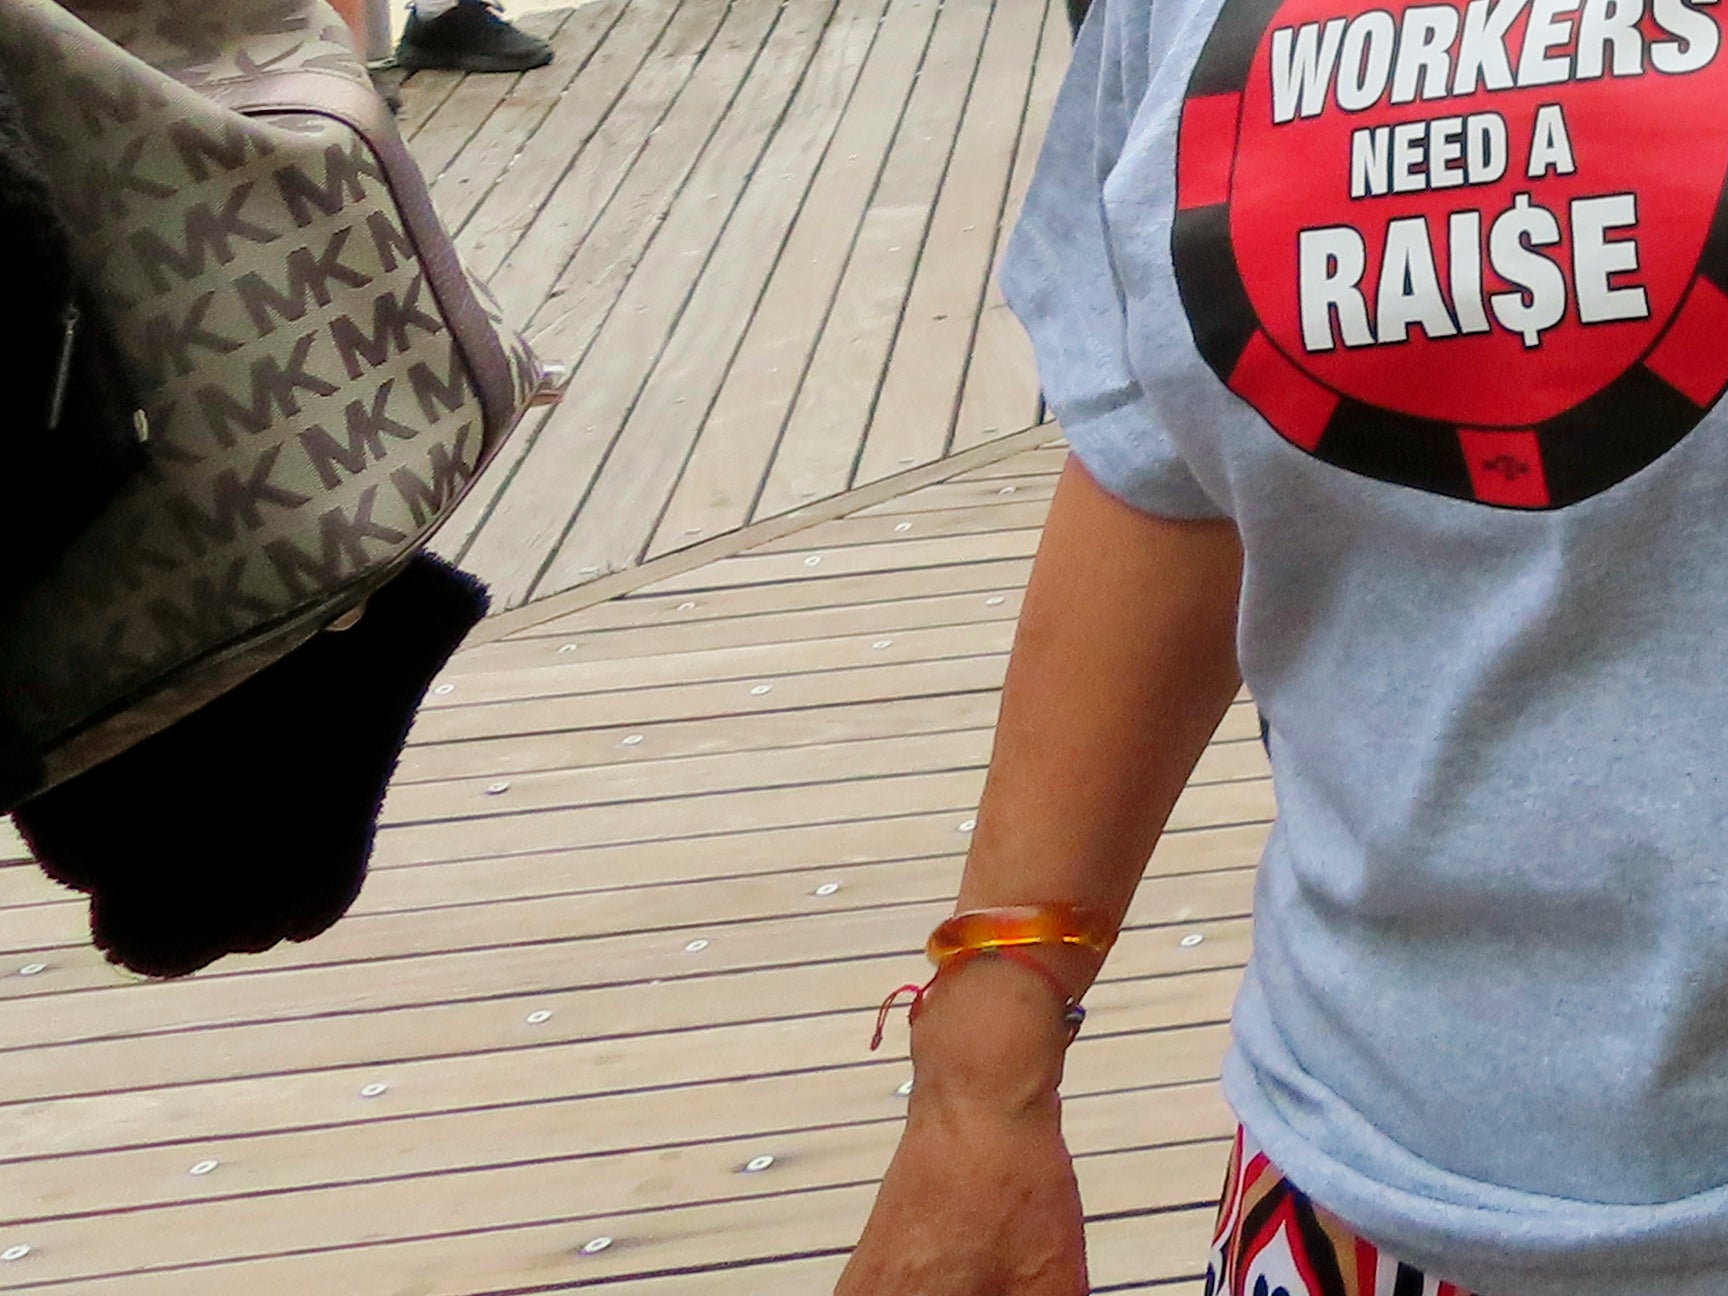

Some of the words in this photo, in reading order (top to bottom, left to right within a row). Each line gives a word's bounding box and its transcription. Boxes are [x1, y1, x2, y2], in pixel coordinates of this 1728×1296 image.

[1349, 111, 1509, 200] NEED
[1526, 103, 1577, 181] A
[129, 180, 281, 296] MK
[234, 225, 373, 338] MK
[329, 272, 443, 380] MK
[199, 329, 341, 449] MK
[301, 377, 419, 490] MK
